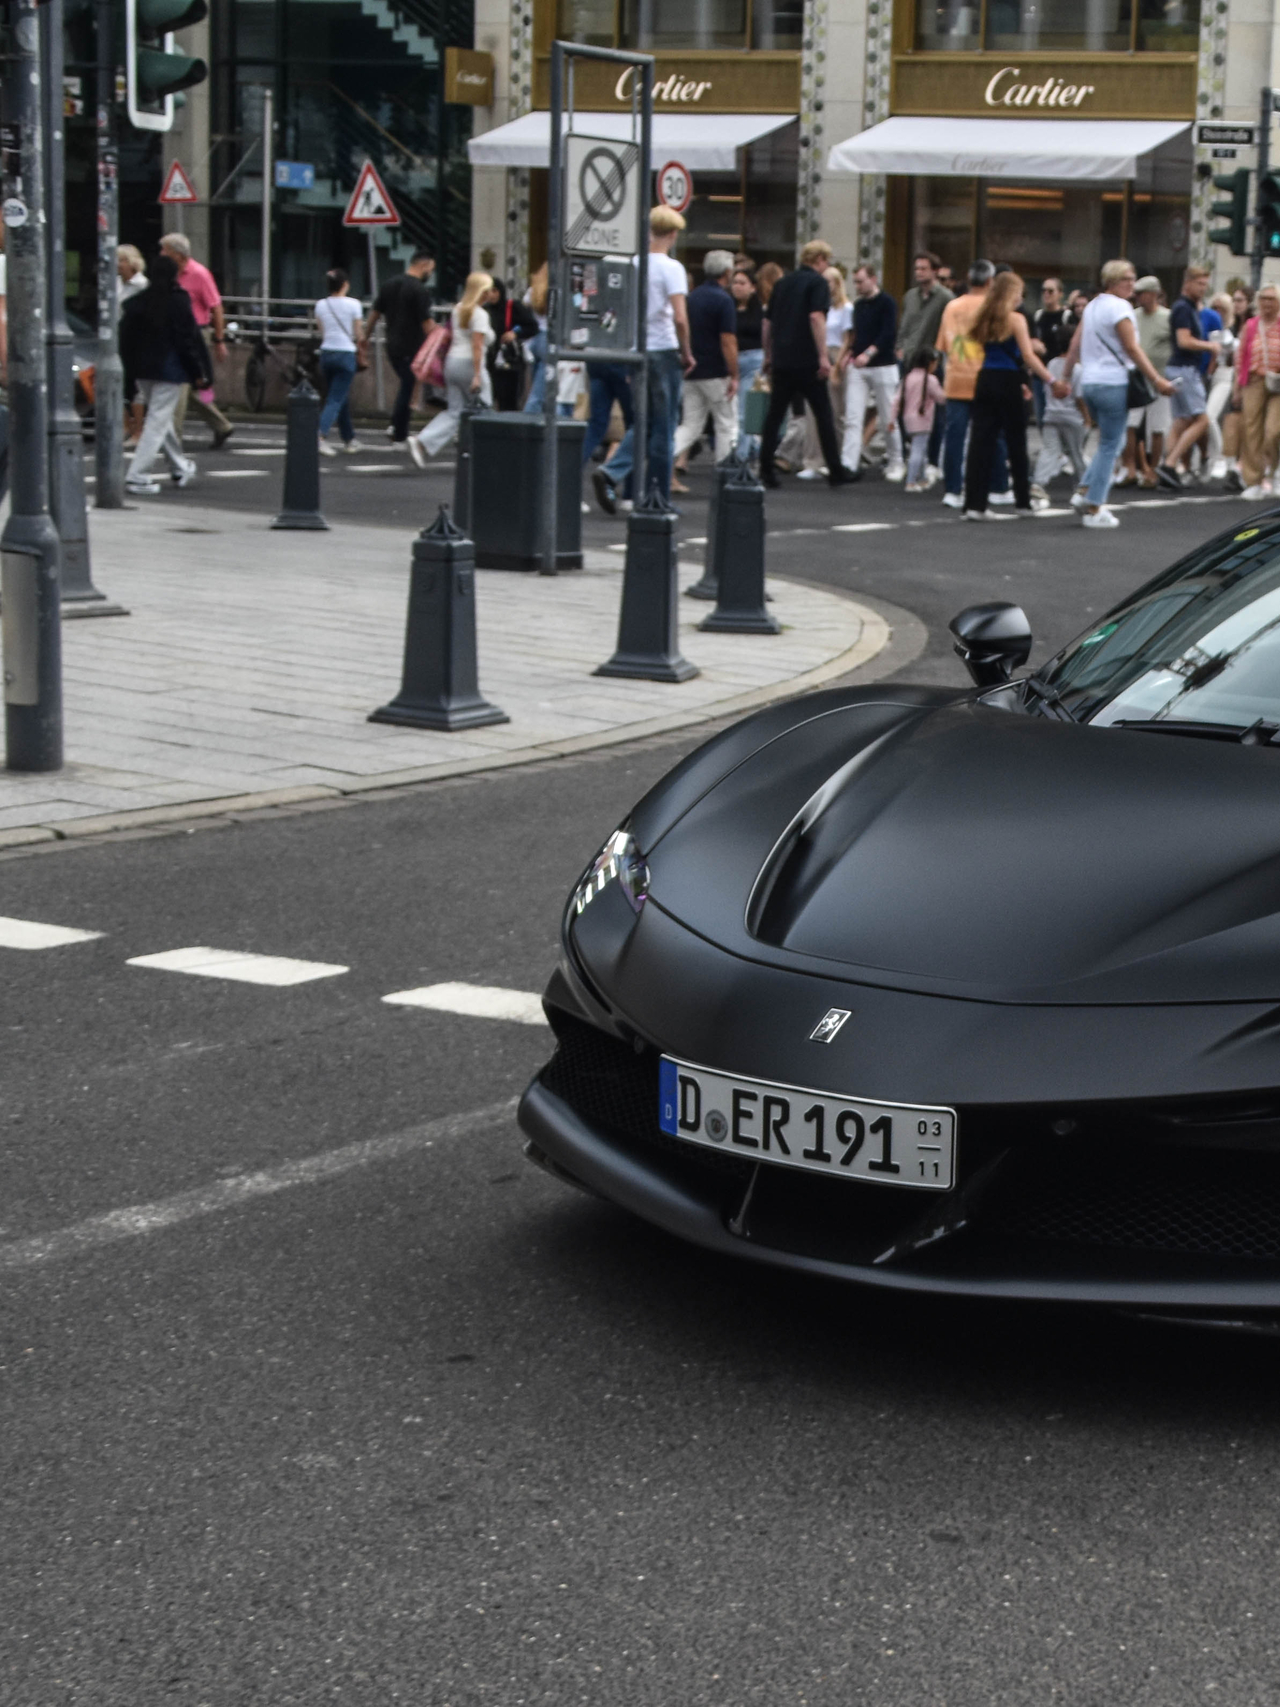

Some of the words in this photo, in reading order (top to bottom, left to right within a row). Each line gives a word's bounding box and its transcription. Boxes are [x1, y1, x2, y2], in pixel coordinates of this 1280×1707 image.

[614, 64, 713, 103] Crtier
[984, 66, 1096, 107] Cartier
[665, 176, 685, 203] 30
[582, 226, 620, 248] ZONE
[678, 1074, 701, 1132] D
[803, 1104, 900, 1174] 191
[917, 1119, 942, 1137] 03
[918, 1161, 940, 1178] 11
